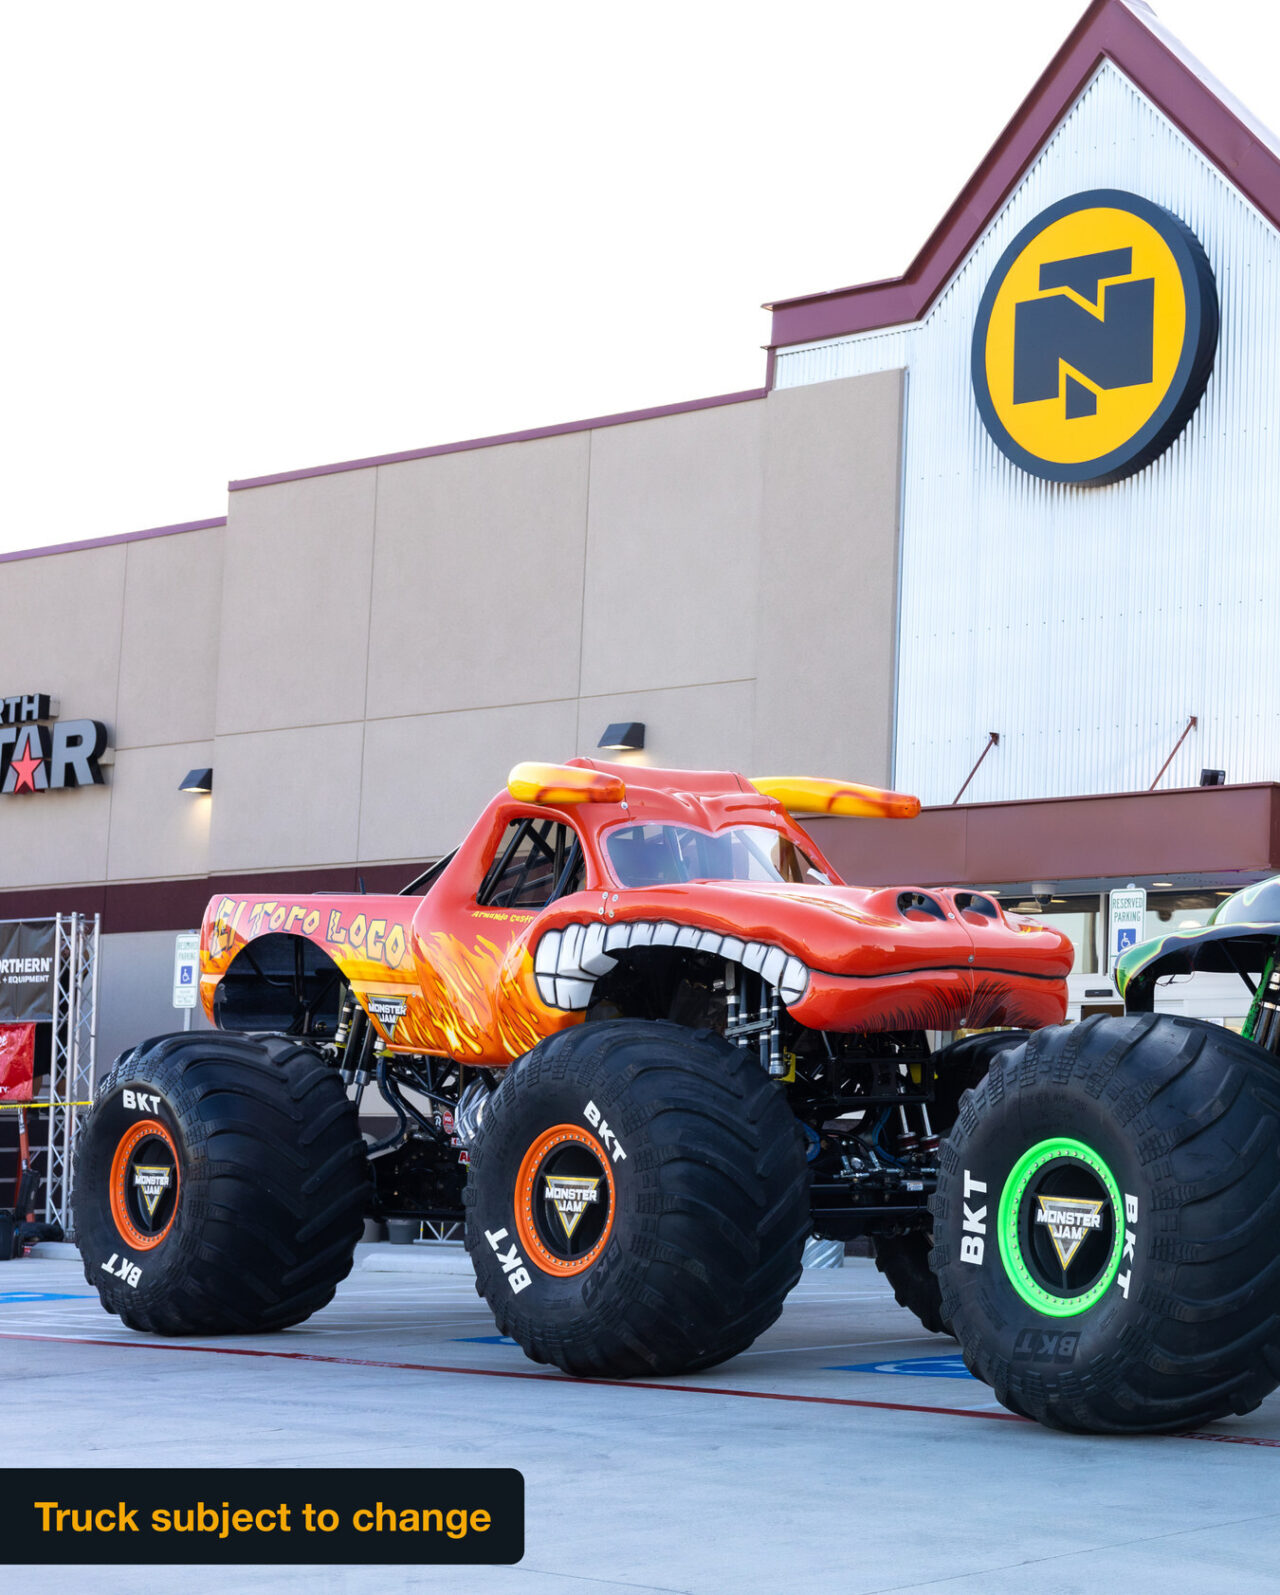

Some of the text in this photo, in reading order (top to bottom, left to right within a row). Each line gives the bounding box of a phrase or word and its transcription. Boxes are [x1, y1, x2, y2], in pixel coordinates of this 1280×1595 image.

[0, 693, 49, 724] TH
[1112, 898, 1143, 909] RESERVED
[1114, 911, 1141, 922] PARKING
[209, 896, 249, 960] El
[247, 900, 321, 941] Toro
[0, 957, 50, 974] RTHERN
[8, 975, 49, 984] EQUIPMENT
[368, 1002, 408, 1016] MONSTER
[378, 1014, 397, 1023] JAM
[122, 1089, 161, 1115] BKT
[583, 1100, 627, 1163] BKT
[134, 1174, 169, 1186] MONSTER
[143, 1185, 161, 1195] JAM
[545, 1187, 598, 1201] MONSTER
[558, 1200, 583, 1213] JAM
[960, 1169, 988, 1266] BKT
[1036, 1208, 1101, 1228] MONSTER
[1053, 1225, 1083, 1240] JAM
[1117, 1193, 1139, 1300] BKT
[484, 1227, 532, 1295] BKT
[101, 1252, 143, 1289] BKT
